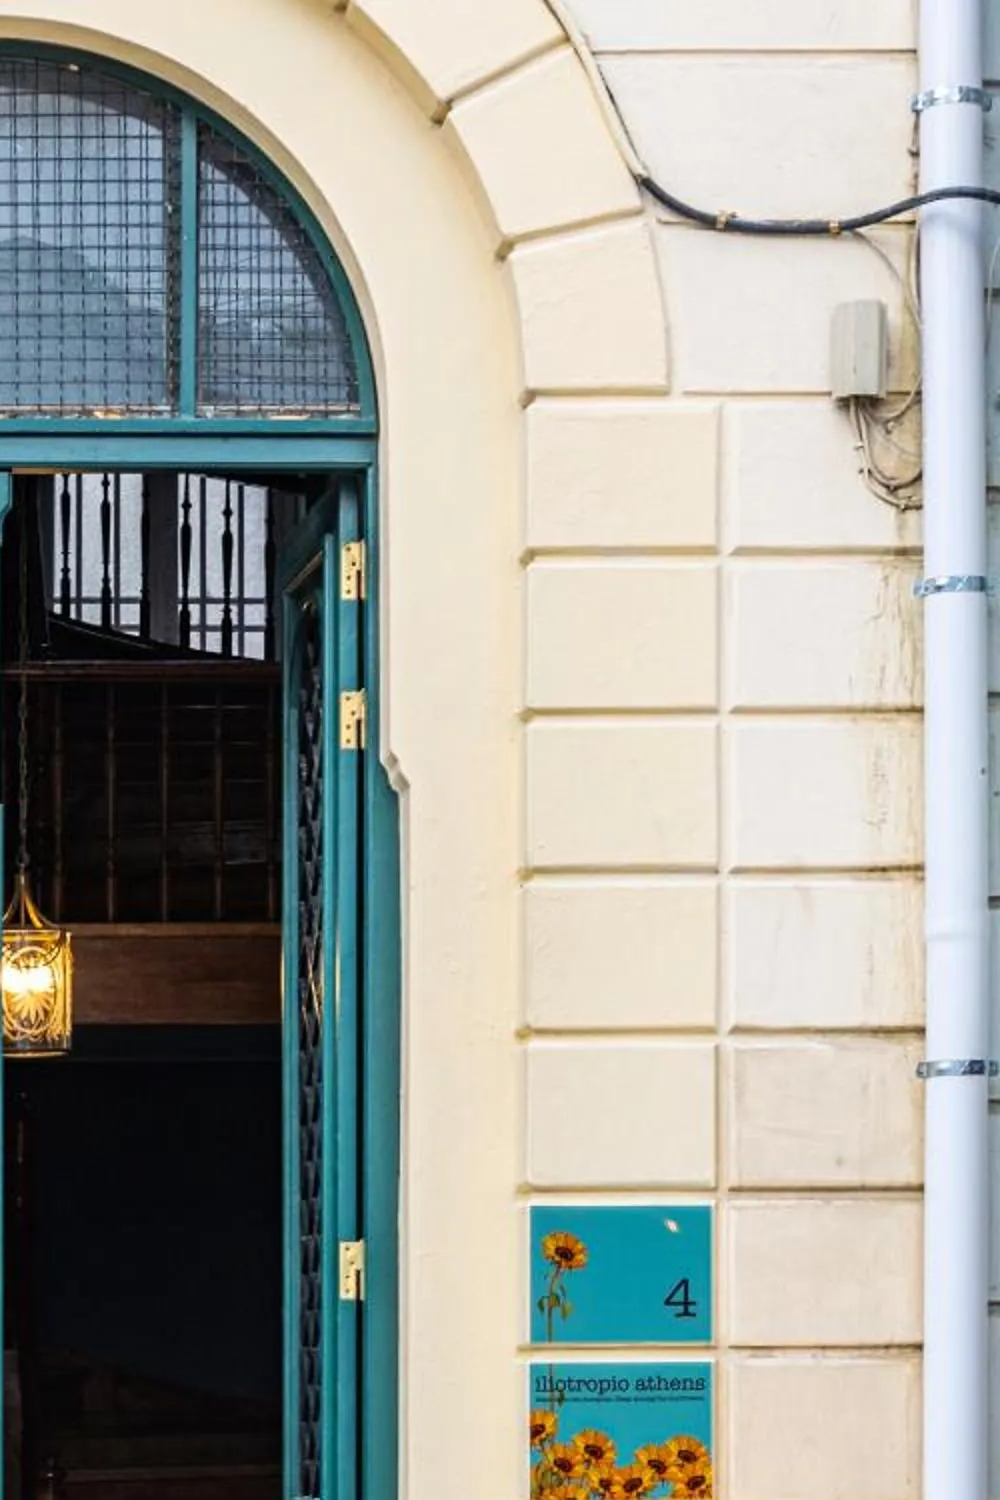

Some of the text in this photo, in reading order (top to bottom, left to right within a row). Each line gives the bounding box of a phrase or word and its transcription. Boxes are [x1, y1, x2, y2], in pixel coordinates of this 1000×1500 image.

[664, 1278, 697, 1317] 4
[535, 1375, 705, 1395] iliotropio athens
